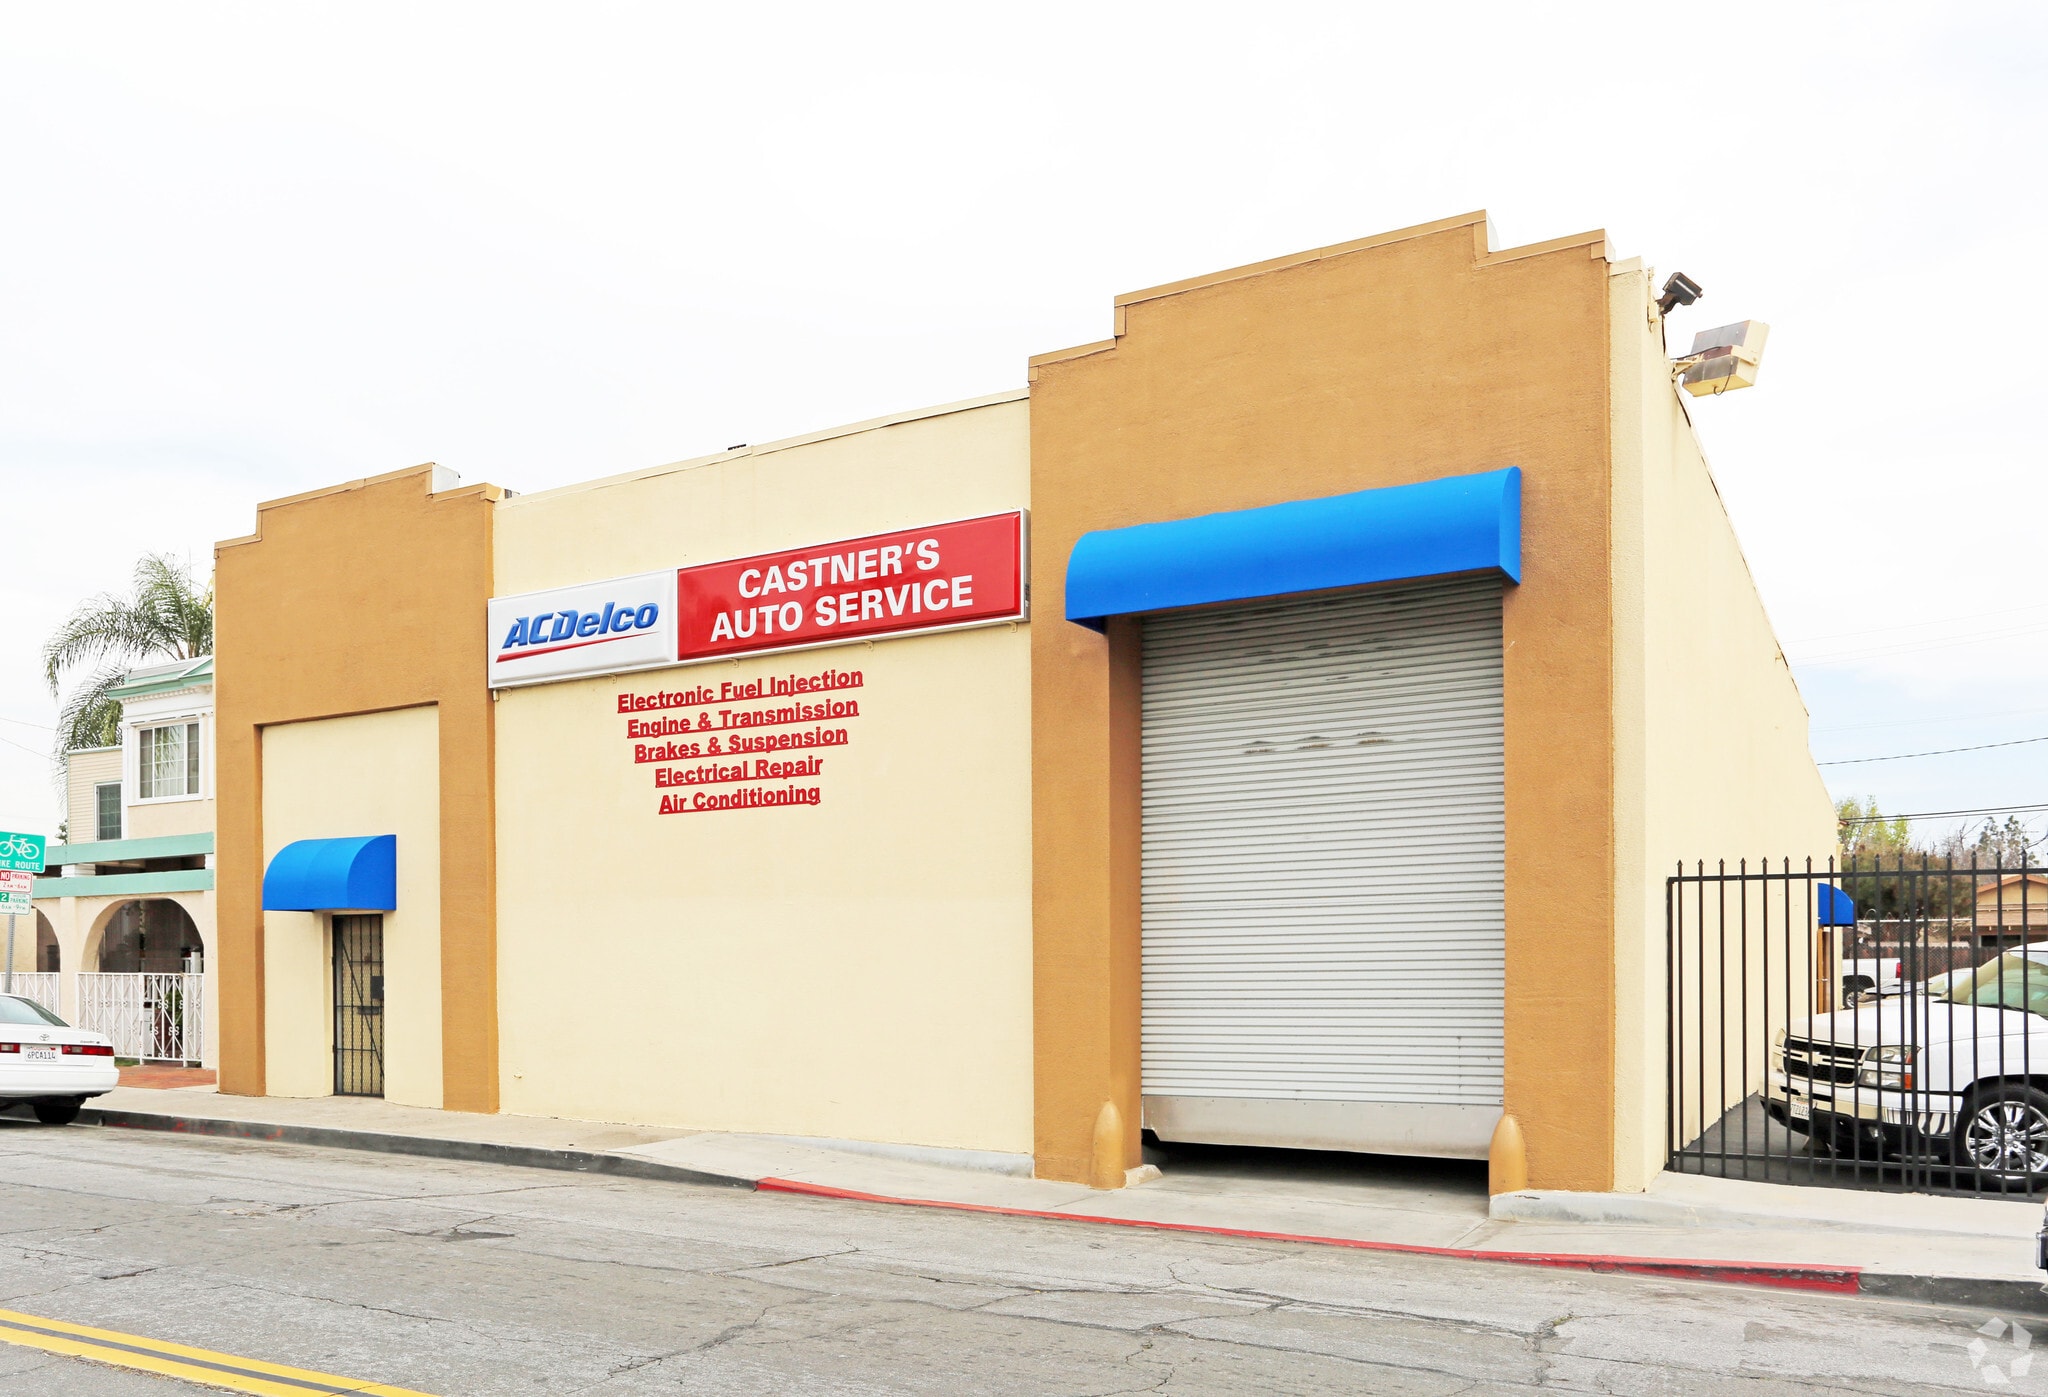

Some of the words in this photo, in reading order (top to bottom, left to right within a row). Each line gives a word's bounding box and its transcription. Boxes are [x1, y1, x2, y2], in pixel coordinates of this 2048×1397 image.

[738, 538, 940, 599] CASTNER'S
[501, 601, 659, 650] ACDelco
[709, 599, 802, 643] AUTO
[815, 575, 974, 627] SERVICE
[618, 685, 714, 713] Electronic
[720, 678, 763, 702] Fuel
[770, 669, 863, 697] Injection
[627, 716, 691, 739] Engine
[697, 711, 711, 731] &
[718, 698, 859, 729] Transmission
[635, 741, 701, 763] Brakes
[707, 736, 722, 755] &
[728, 726, 848, 753] Suspension
[655, 760, 748, 788] Electrical
[755, 755, 824, 780] Repair
[659, 794, 687, 814] Air
[693, 784, 820, 811] Conditioning
[0, 871, 10, 880] NO
[15, 861, 40, 870] ROUTE
[1, 893, 7, 901] 2
[27, 1051, 56, 1060] 6PCA114
